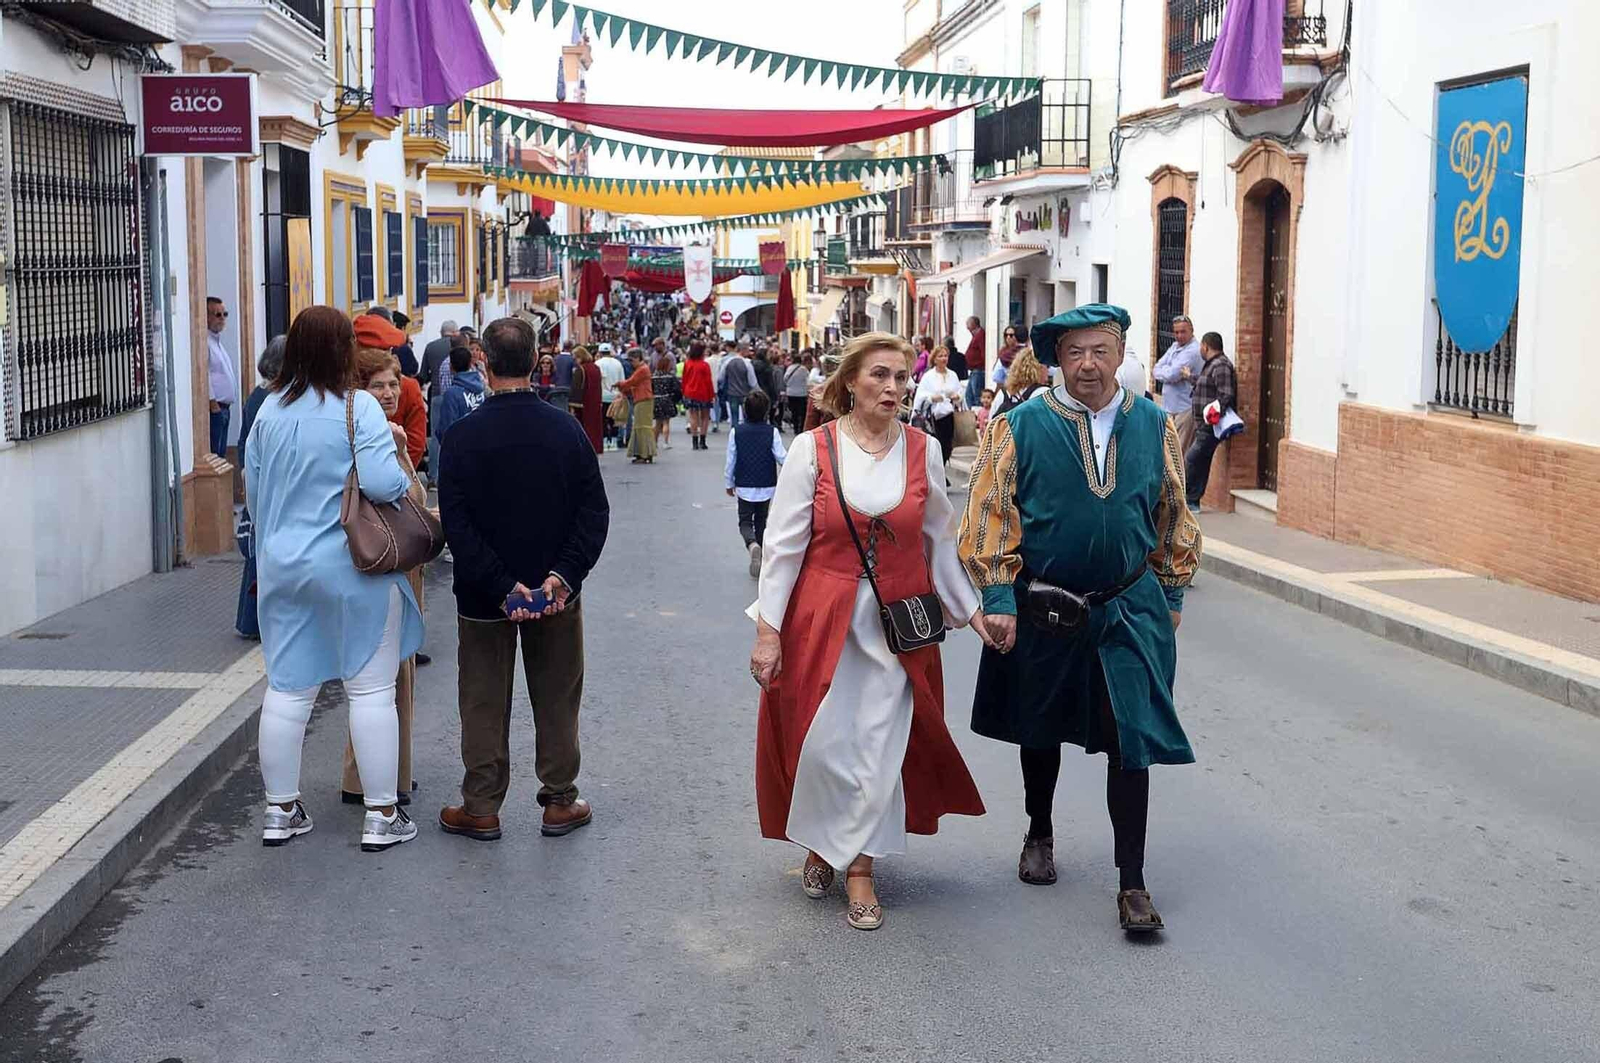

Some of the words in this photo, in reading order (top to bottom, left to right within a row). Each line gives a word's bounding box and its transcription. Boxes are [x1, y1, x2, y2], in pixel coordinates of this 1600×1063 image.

[175, 87, 217, 95] GRUPO
[151, 125, 198, 134] CORREDURÍA
[199, 126, 208, 134] DE
[209, 126, 242, 134] SEGUROS
